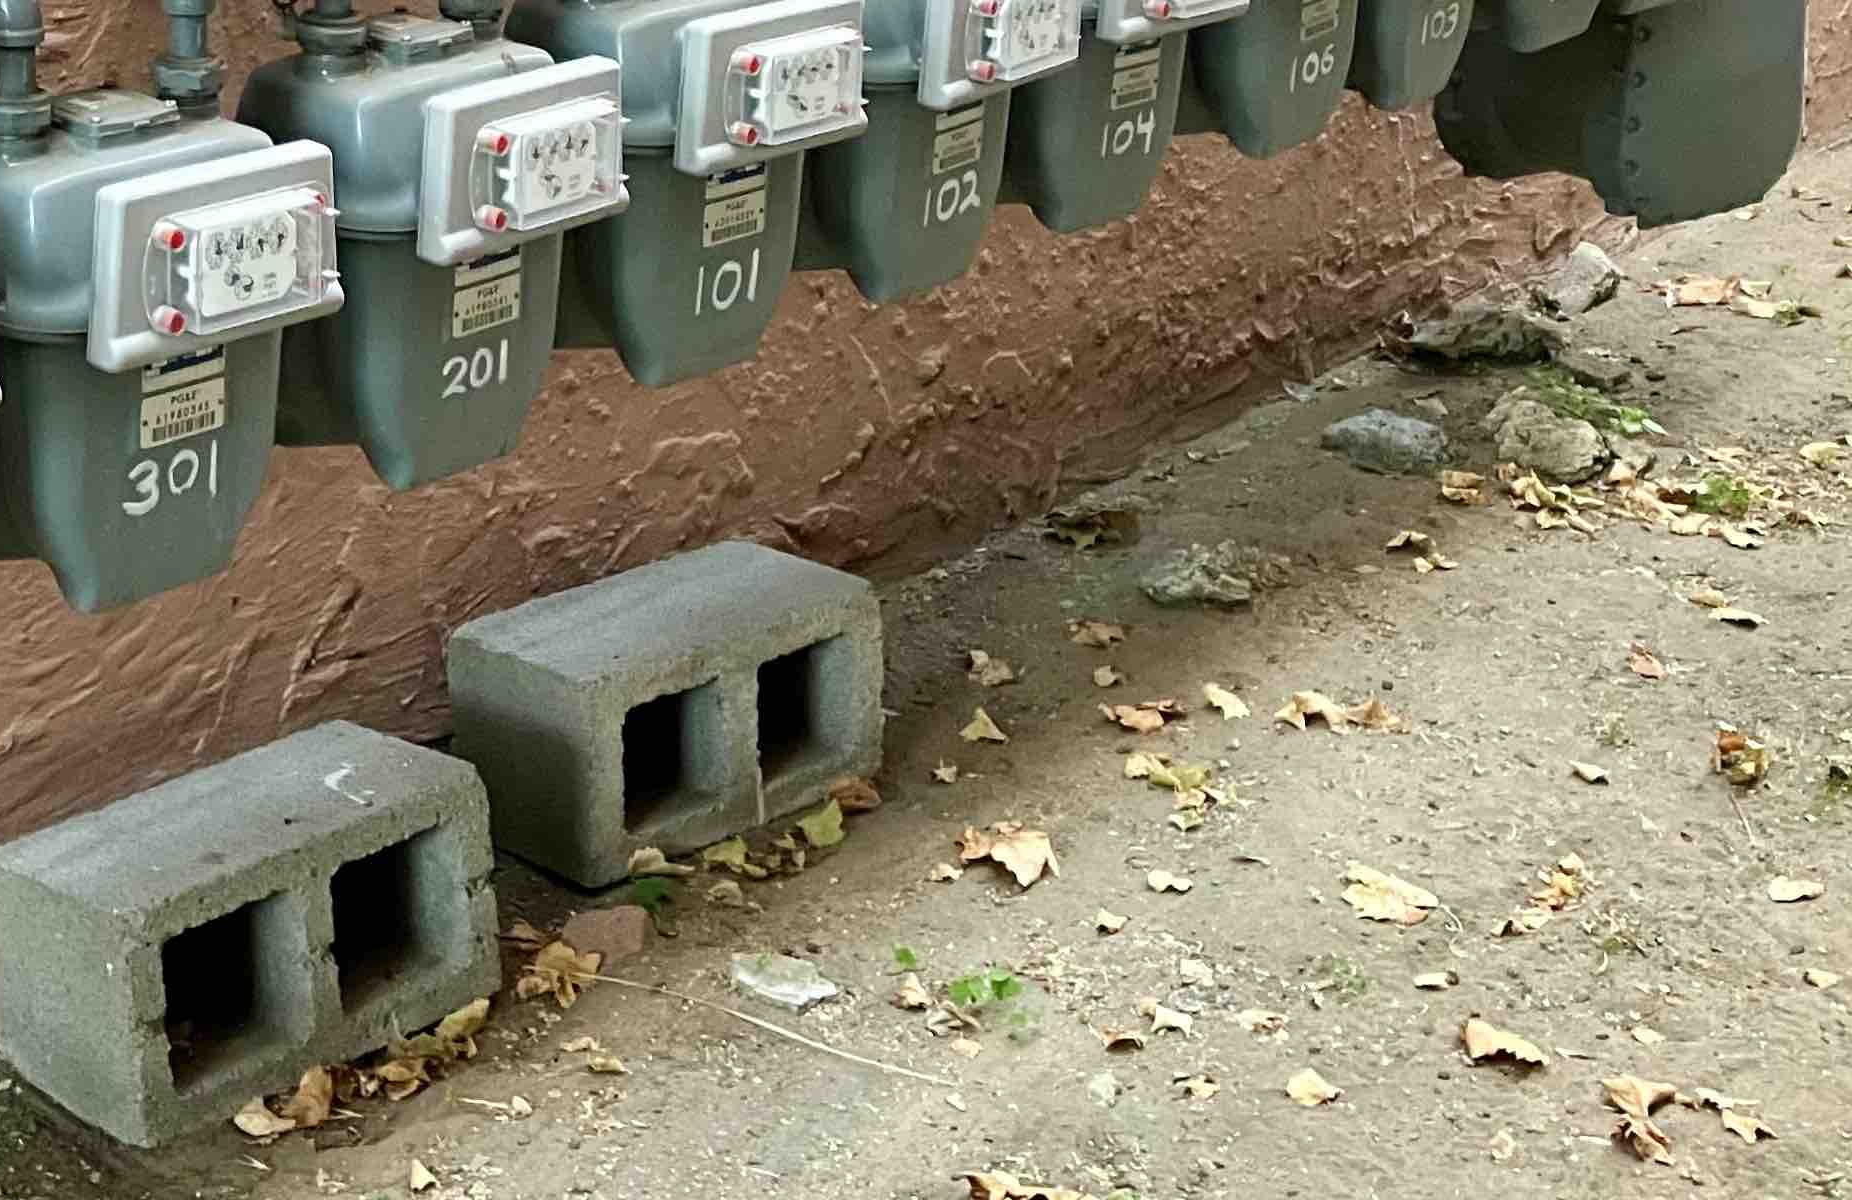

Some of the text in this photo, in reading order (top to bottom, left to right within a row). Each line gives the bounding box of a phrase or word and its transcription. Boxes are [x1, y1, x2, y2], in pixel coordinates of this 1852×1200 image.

[1420, 3, 1460, 45] 103
[1290, 43, 1336, 93] 106
[1101, 107, 1156, 160] 104
[923, 169, 981, 228] 102
[694, 248, 760, 316] 101
[441, 339, 508, 399] 201
[122, 440, 218, 515] 301
